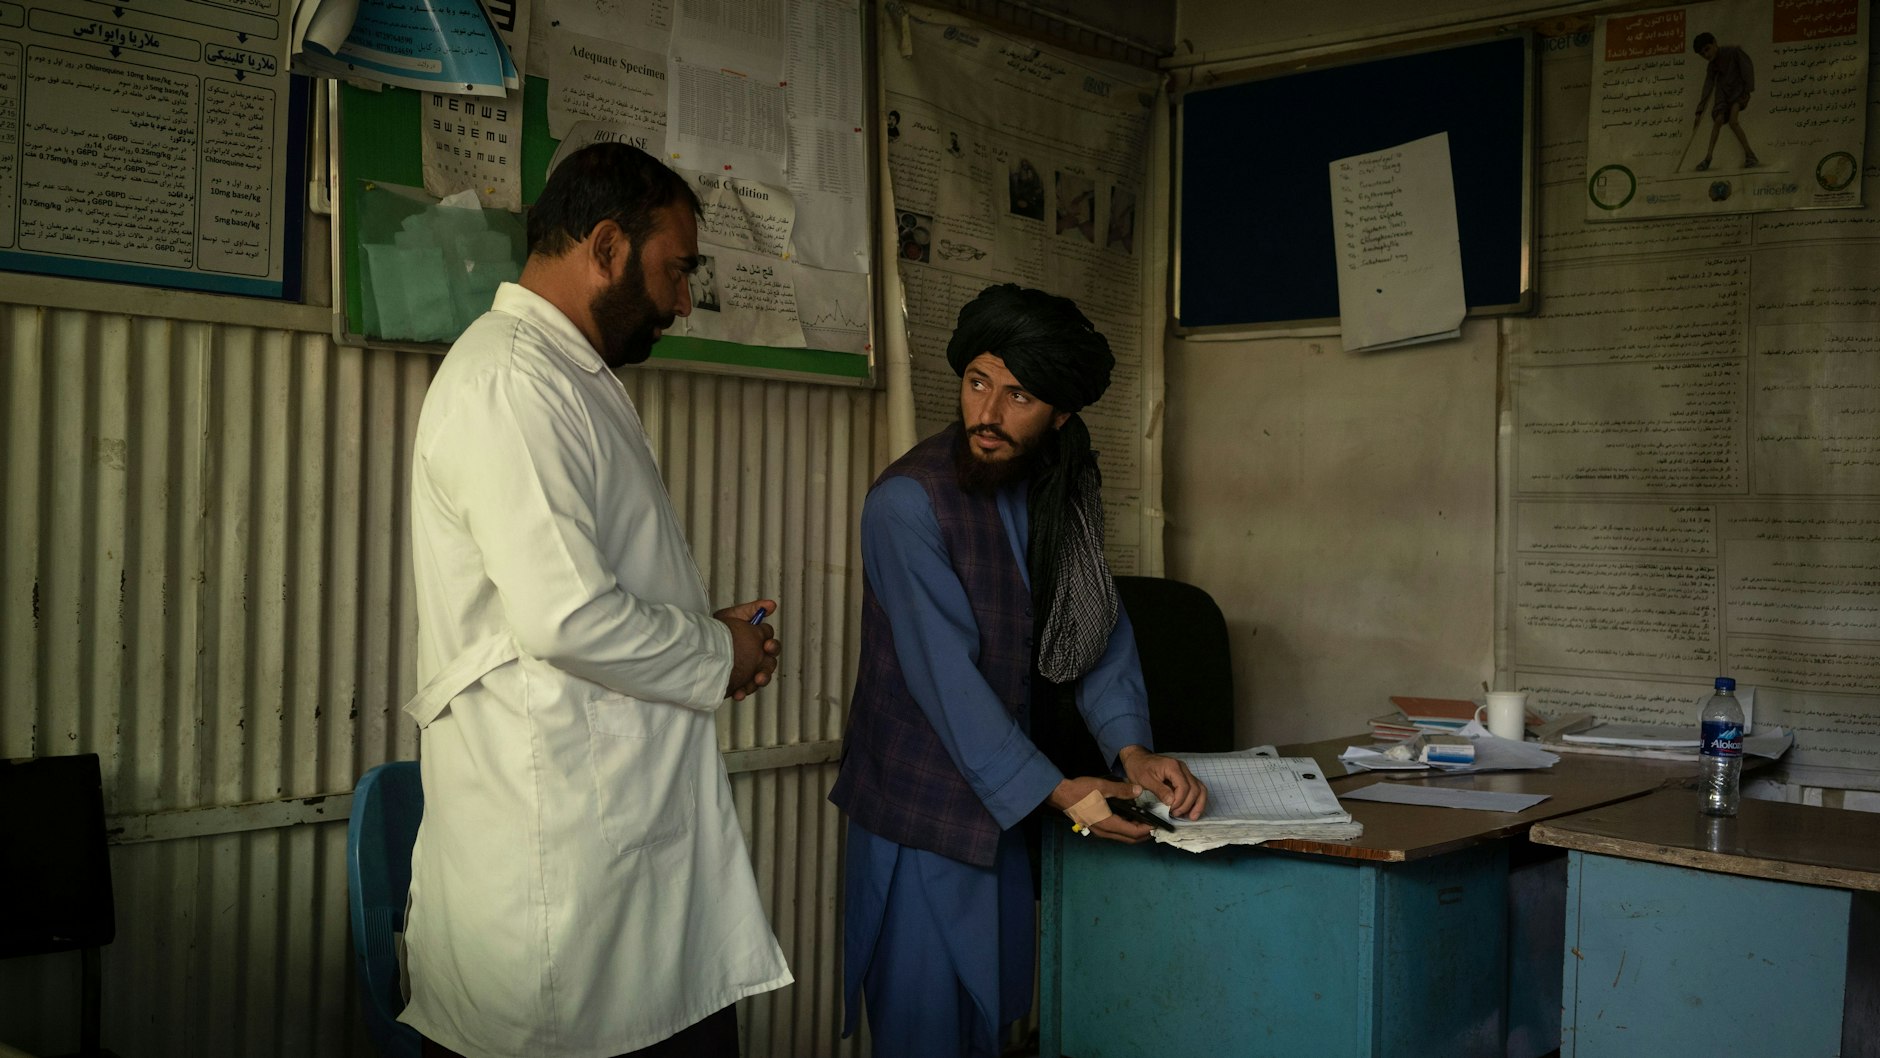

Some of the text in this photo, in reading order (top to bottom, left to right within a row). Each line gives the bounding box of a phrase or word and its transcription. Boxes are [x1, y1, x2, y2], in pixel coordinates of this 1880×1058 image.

[129, 31, 160, 49] ملاریا
[207, 50, 275, 71] ملاریا کلینیکی
[570, 45, 665, 81] Adequate Specimen
[85, 63, 125, 77] Chloroquine
[126, 71, 145, 81] 10mg
[146, 74, 172, 86] base/kg
[150, 84, 166, 95] 5mg
[166, 86, 190, 99] base/kg
[107, 133, 128, 143] G6PD
[39, 152, 78, 166] 0.75mg/kg
[76, 148, 98, 157] G6PD
[135, 148, 172, 160] 0.25mg/kg
[205, 155, 244, 168] Chloroquine
[699, 175, 720, 189] Good
[105, 190, 126, 199] G6PD
[210, 188, 261, 203] 10mg base/kg
[22, 198, 62, 211] 0.75mg/kg
[92, 198, 113, 207] G6PD
[215, 216, 260, 231] 5mg base/kg
[155, 244, 176, 252] G6PD
